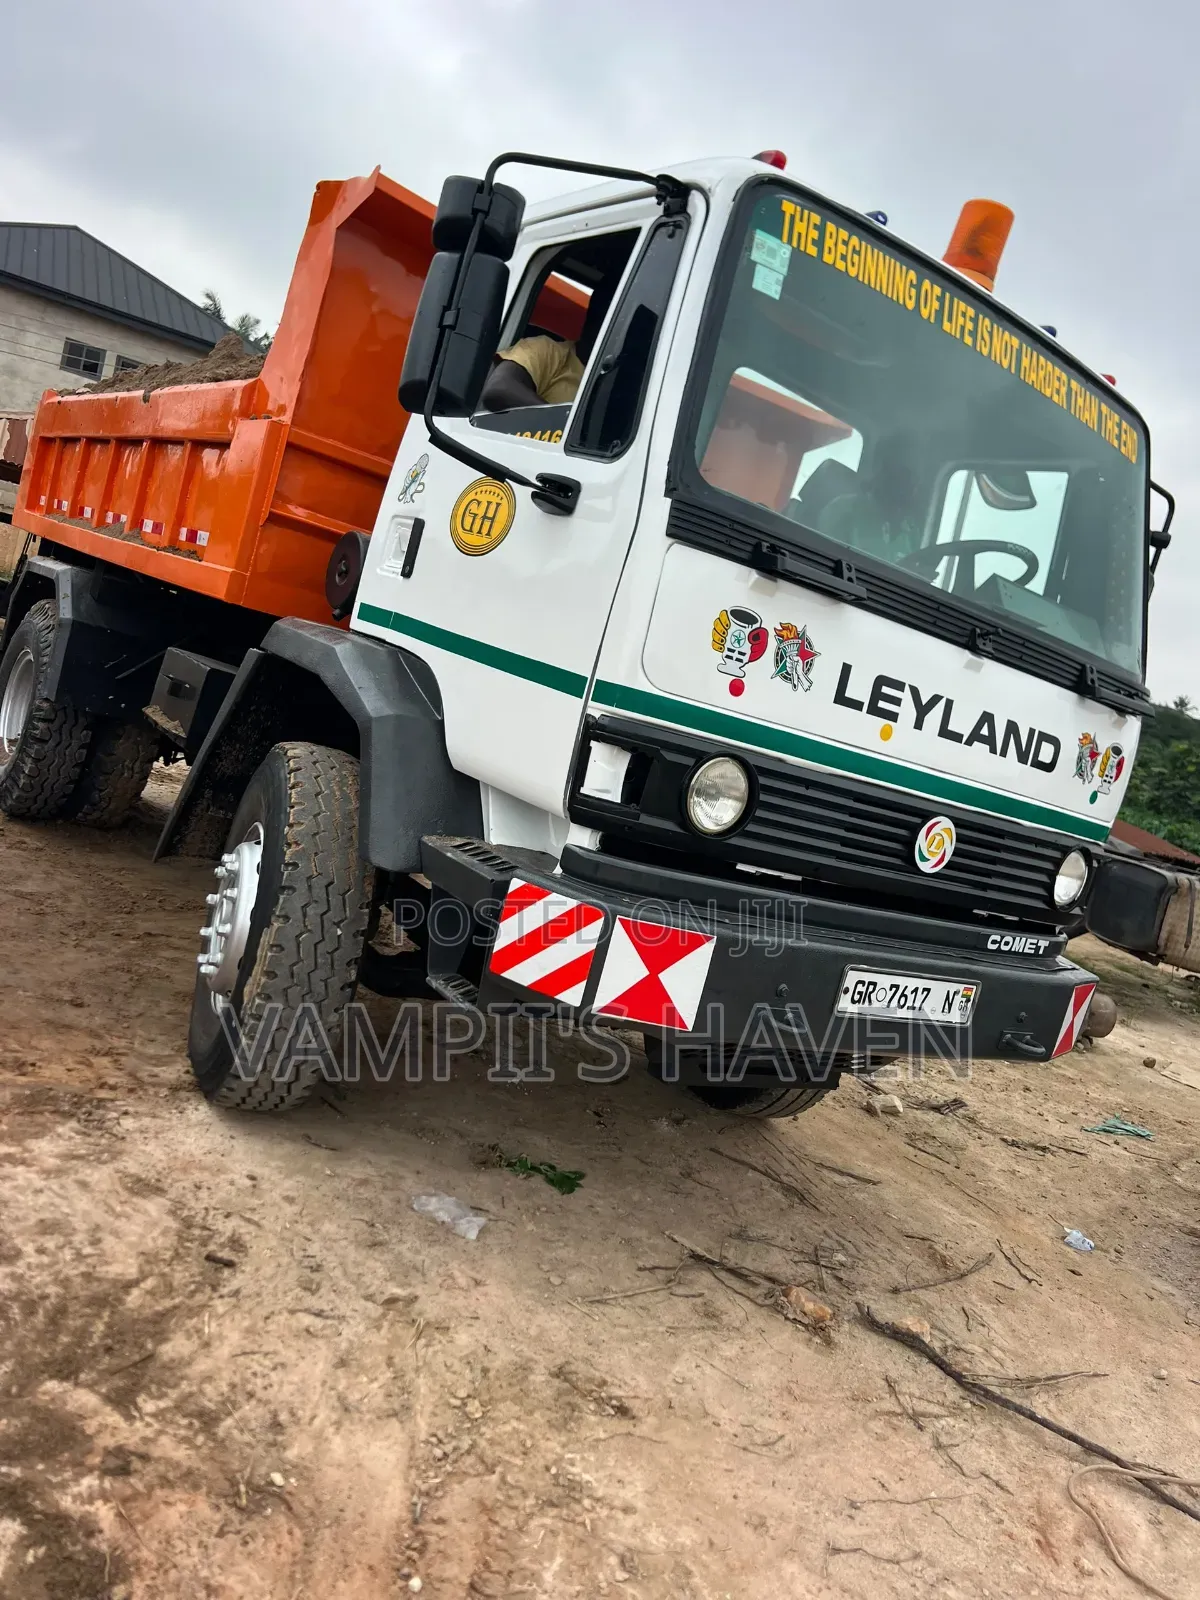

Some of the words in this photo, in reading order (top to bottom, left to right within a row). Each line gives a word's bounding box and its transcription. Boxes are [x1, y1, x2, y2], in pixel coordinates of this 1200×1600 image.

[781, 199, 822, 258] THE
[822, 221, 917, 311] BEGINNING
[919, 279, 942, 324] OF
[942, 292, 976, 347] LIFE
[976, 314, 991, 357] IS
[991, 323, 1019, 374] NOT
[1020, 343, 1068, 410] HARDER
[1070, 378, 1099, 432] THAN
[1101, 402, 1120, 449] THE
[1120, 420, 1138, 464] END
[460, 498, 503, 539] GH
[833, 662, 1062, 773] LEYLAND
[987, 934, 1050, 955] COMET
[850, 979, 878, 1006] GR
[886, 983, 932, 1012] 7617
[941, 989, 957, 1014] N
